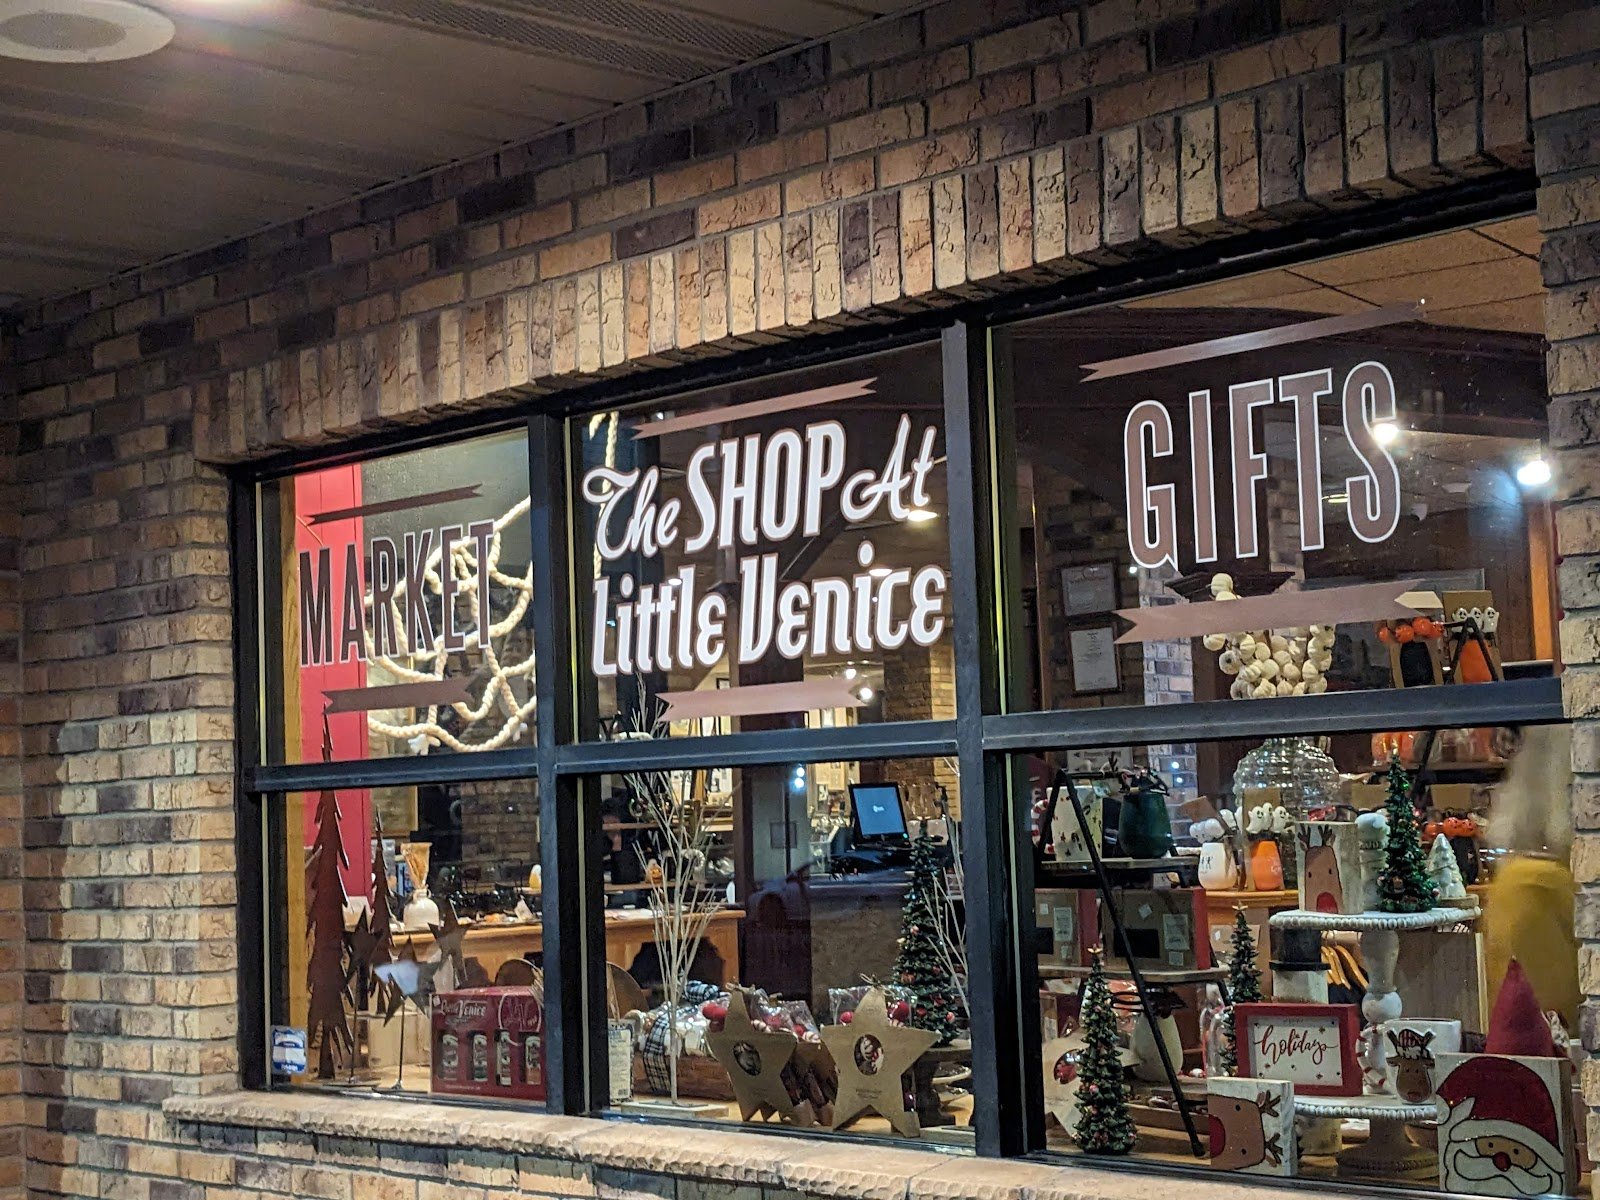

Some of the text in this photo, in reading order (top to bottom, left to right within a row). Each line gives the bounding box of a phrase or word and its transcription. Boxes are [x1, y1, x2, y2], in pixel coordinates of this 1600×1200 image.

[582, 413, 937, 562] The SHOP At
[1124, 361, 1401, 572] GIFTS
[299, 519, 496, 668] MARKET
[591, 541, 947, 676] Little Venice
